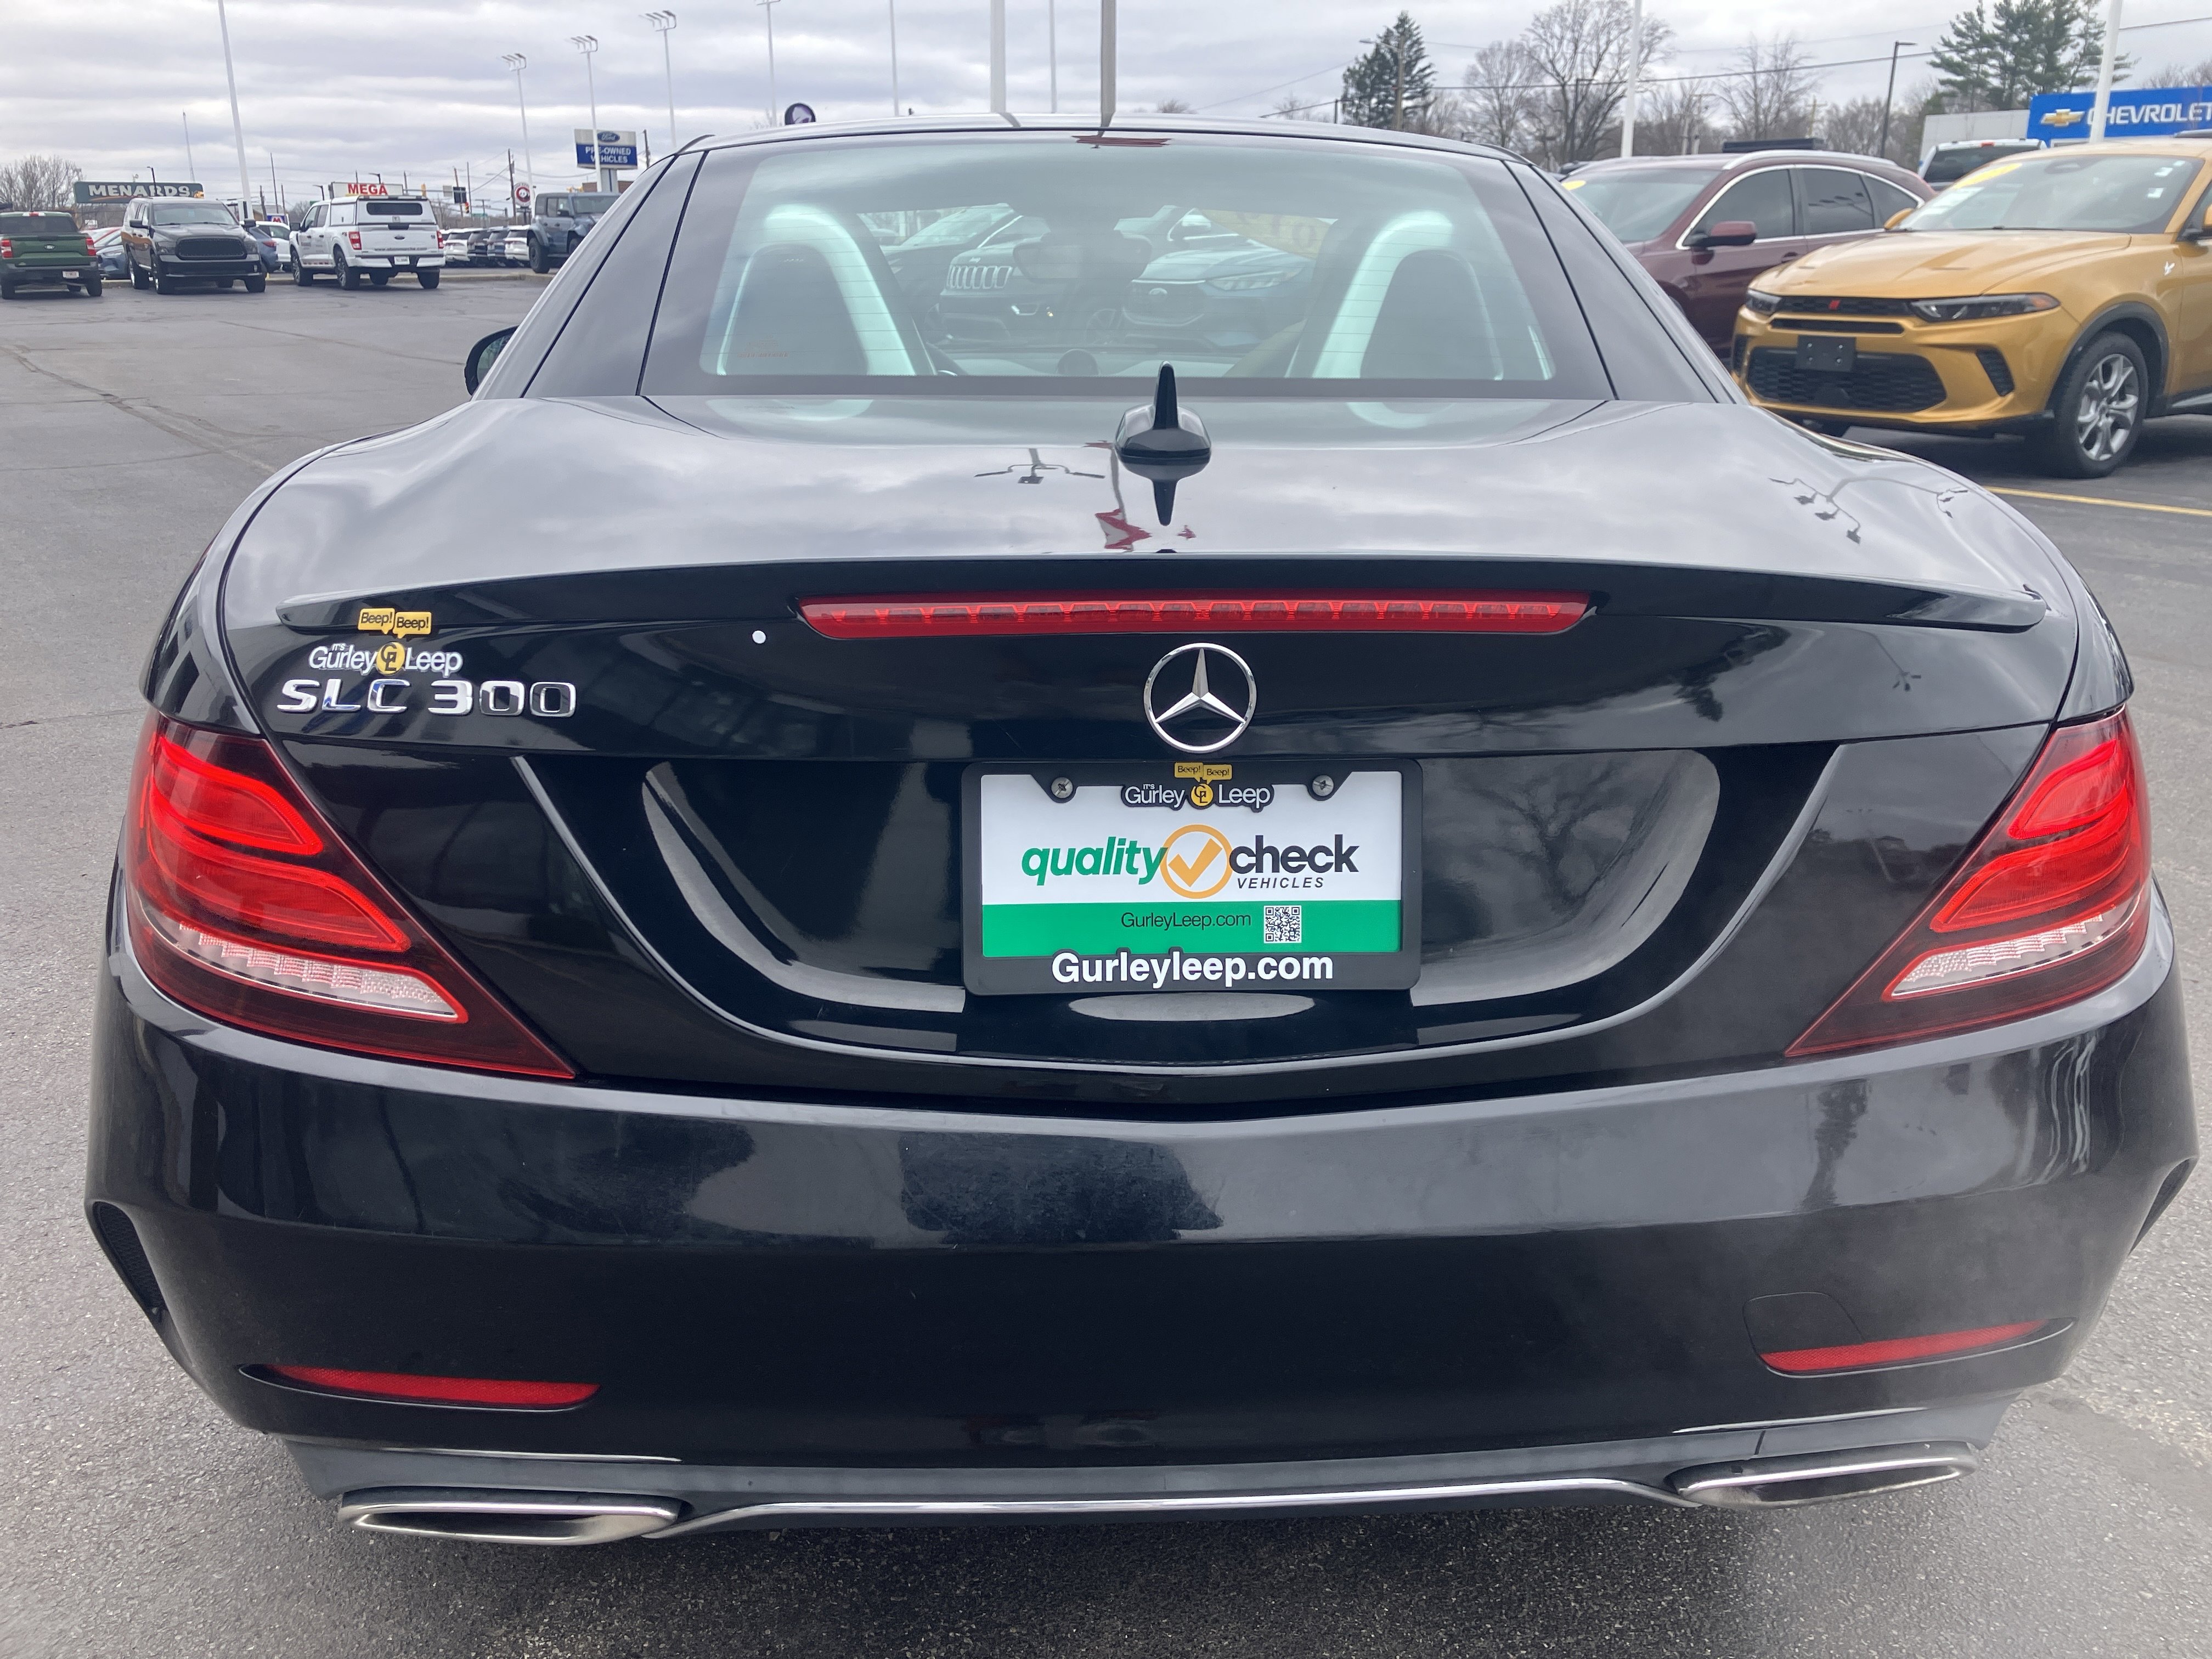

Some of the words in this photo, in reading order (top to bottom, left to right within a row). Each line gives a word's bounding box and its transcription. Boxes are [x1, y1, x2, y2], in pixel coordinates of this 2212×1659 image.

[590, 155, 628, 163] VHICLES
[88, 185, 190, 197] MENARDS
[347, 183, 388, 195] MEGA
[361, 612, 393, 627] Beep!
[396, 617, 429, 631] Beep!
[331, 643, 346, 651] IT'S
[309, 645, 377, 674] Gurley
[405, 647, 463, 676] Leep
[276, 679, 411, 713] SLC
[427, 680, 577, 717] 300
[1177, 765, 1201, 775] Beep!
[1206, 769, 1229, 777] Beep!
[1125, 785, 1185, 808] Gurley
[1218, 784, 1271, 808] Leep
[1022, 836, 1169, 886] quality
[1229, 834, 1360, 874] check
[1237, 877, 1324, 889] VEHICLES
[1121, 912, 1251, 931] GurleyLeep.com
[1052, 951, 1334, 989] Gurleyleep.com
